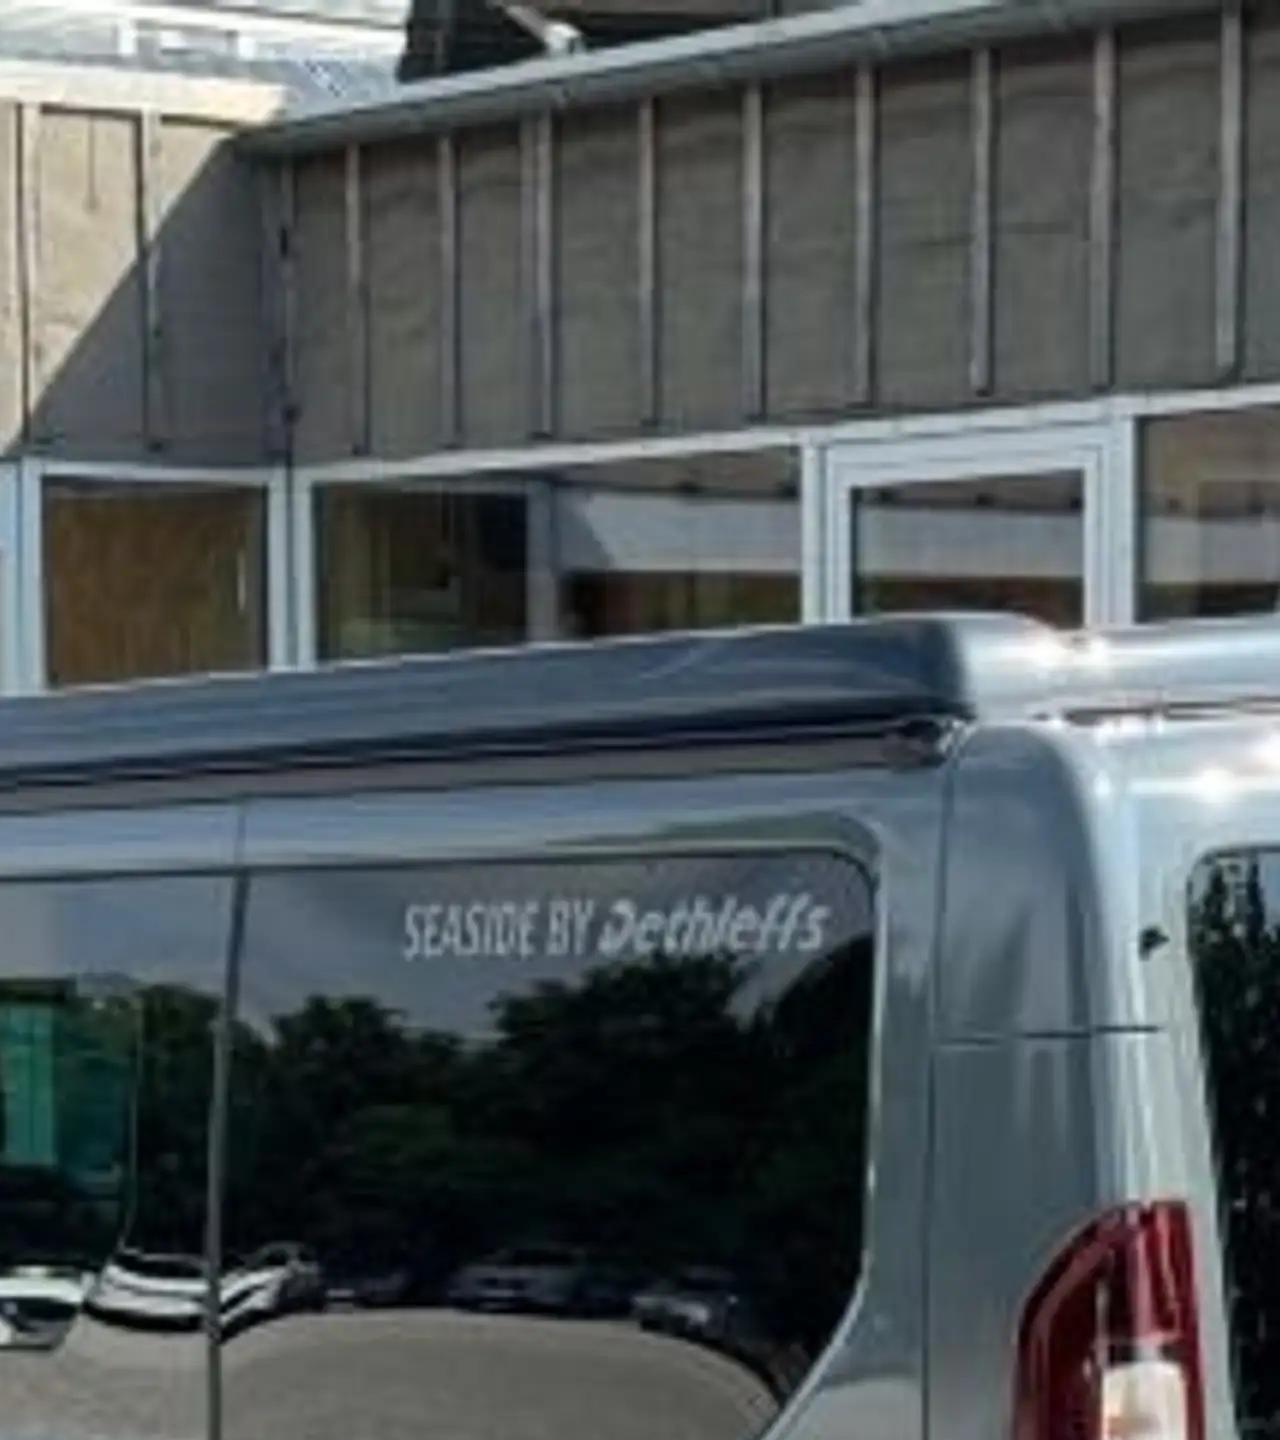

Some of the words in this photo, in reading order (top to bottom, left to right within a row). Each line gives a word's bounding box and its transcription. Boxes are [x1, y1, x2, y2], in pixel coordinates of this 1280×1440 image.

[403, 902, 540, 961] SEASIDE
[546, 899, 596, 957] BY
[597, 893, 832, 956] Dethleffs
